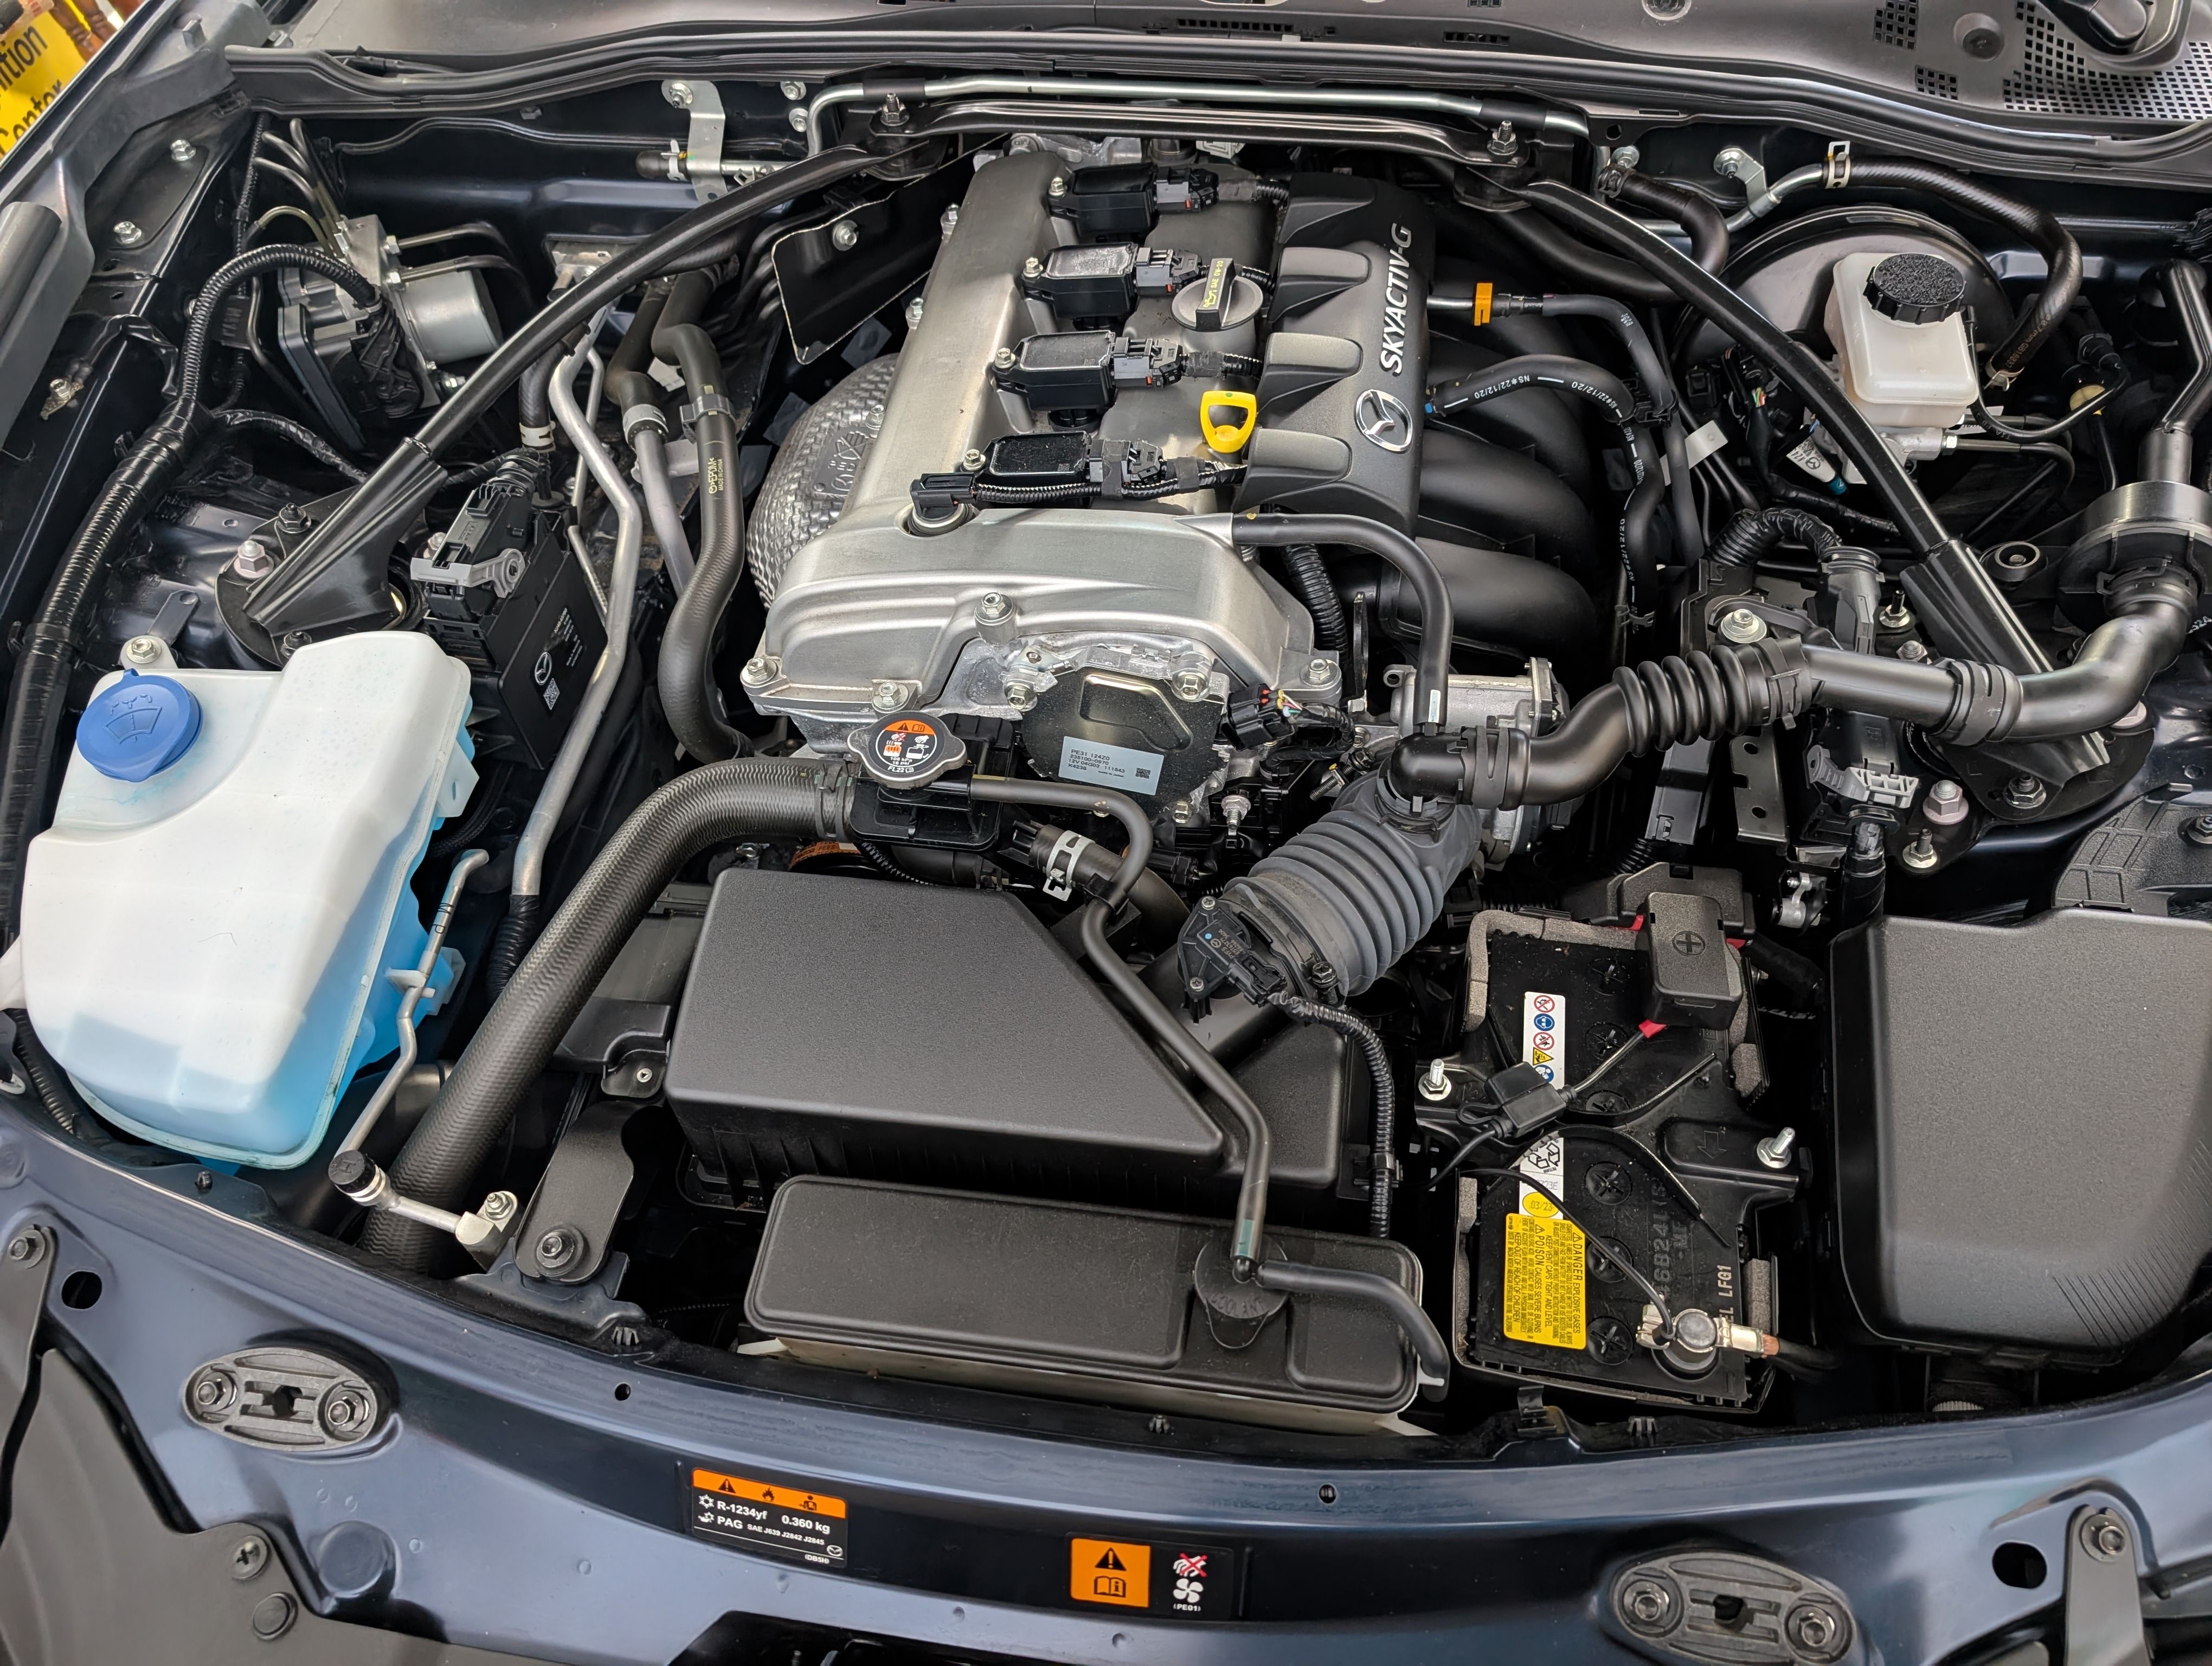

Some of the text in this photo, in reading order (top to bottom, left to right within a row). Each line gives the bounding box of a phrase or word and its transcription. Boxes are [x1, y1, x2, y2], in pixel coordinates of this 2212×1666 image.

[1211, 260, 1224, 288] SAE 0W-20
[1380, 222, 1412, 375] SKYACTIV-G
[1069, 754, 1109, 765] 235100-0970
[1531, 1200, 1554, 1212] 03/23
[1535, 1235, 1545, 1266] POISON
[1573, 1244, 1583, 1280] DANGER
[1717, 1264, 1734, 1297] LFG1
[717, 1500, 831, 1534] R-1234yf 0.360 kg
[717, 1516, 825, 1545] PAG SAE J639 J2842 J2845
